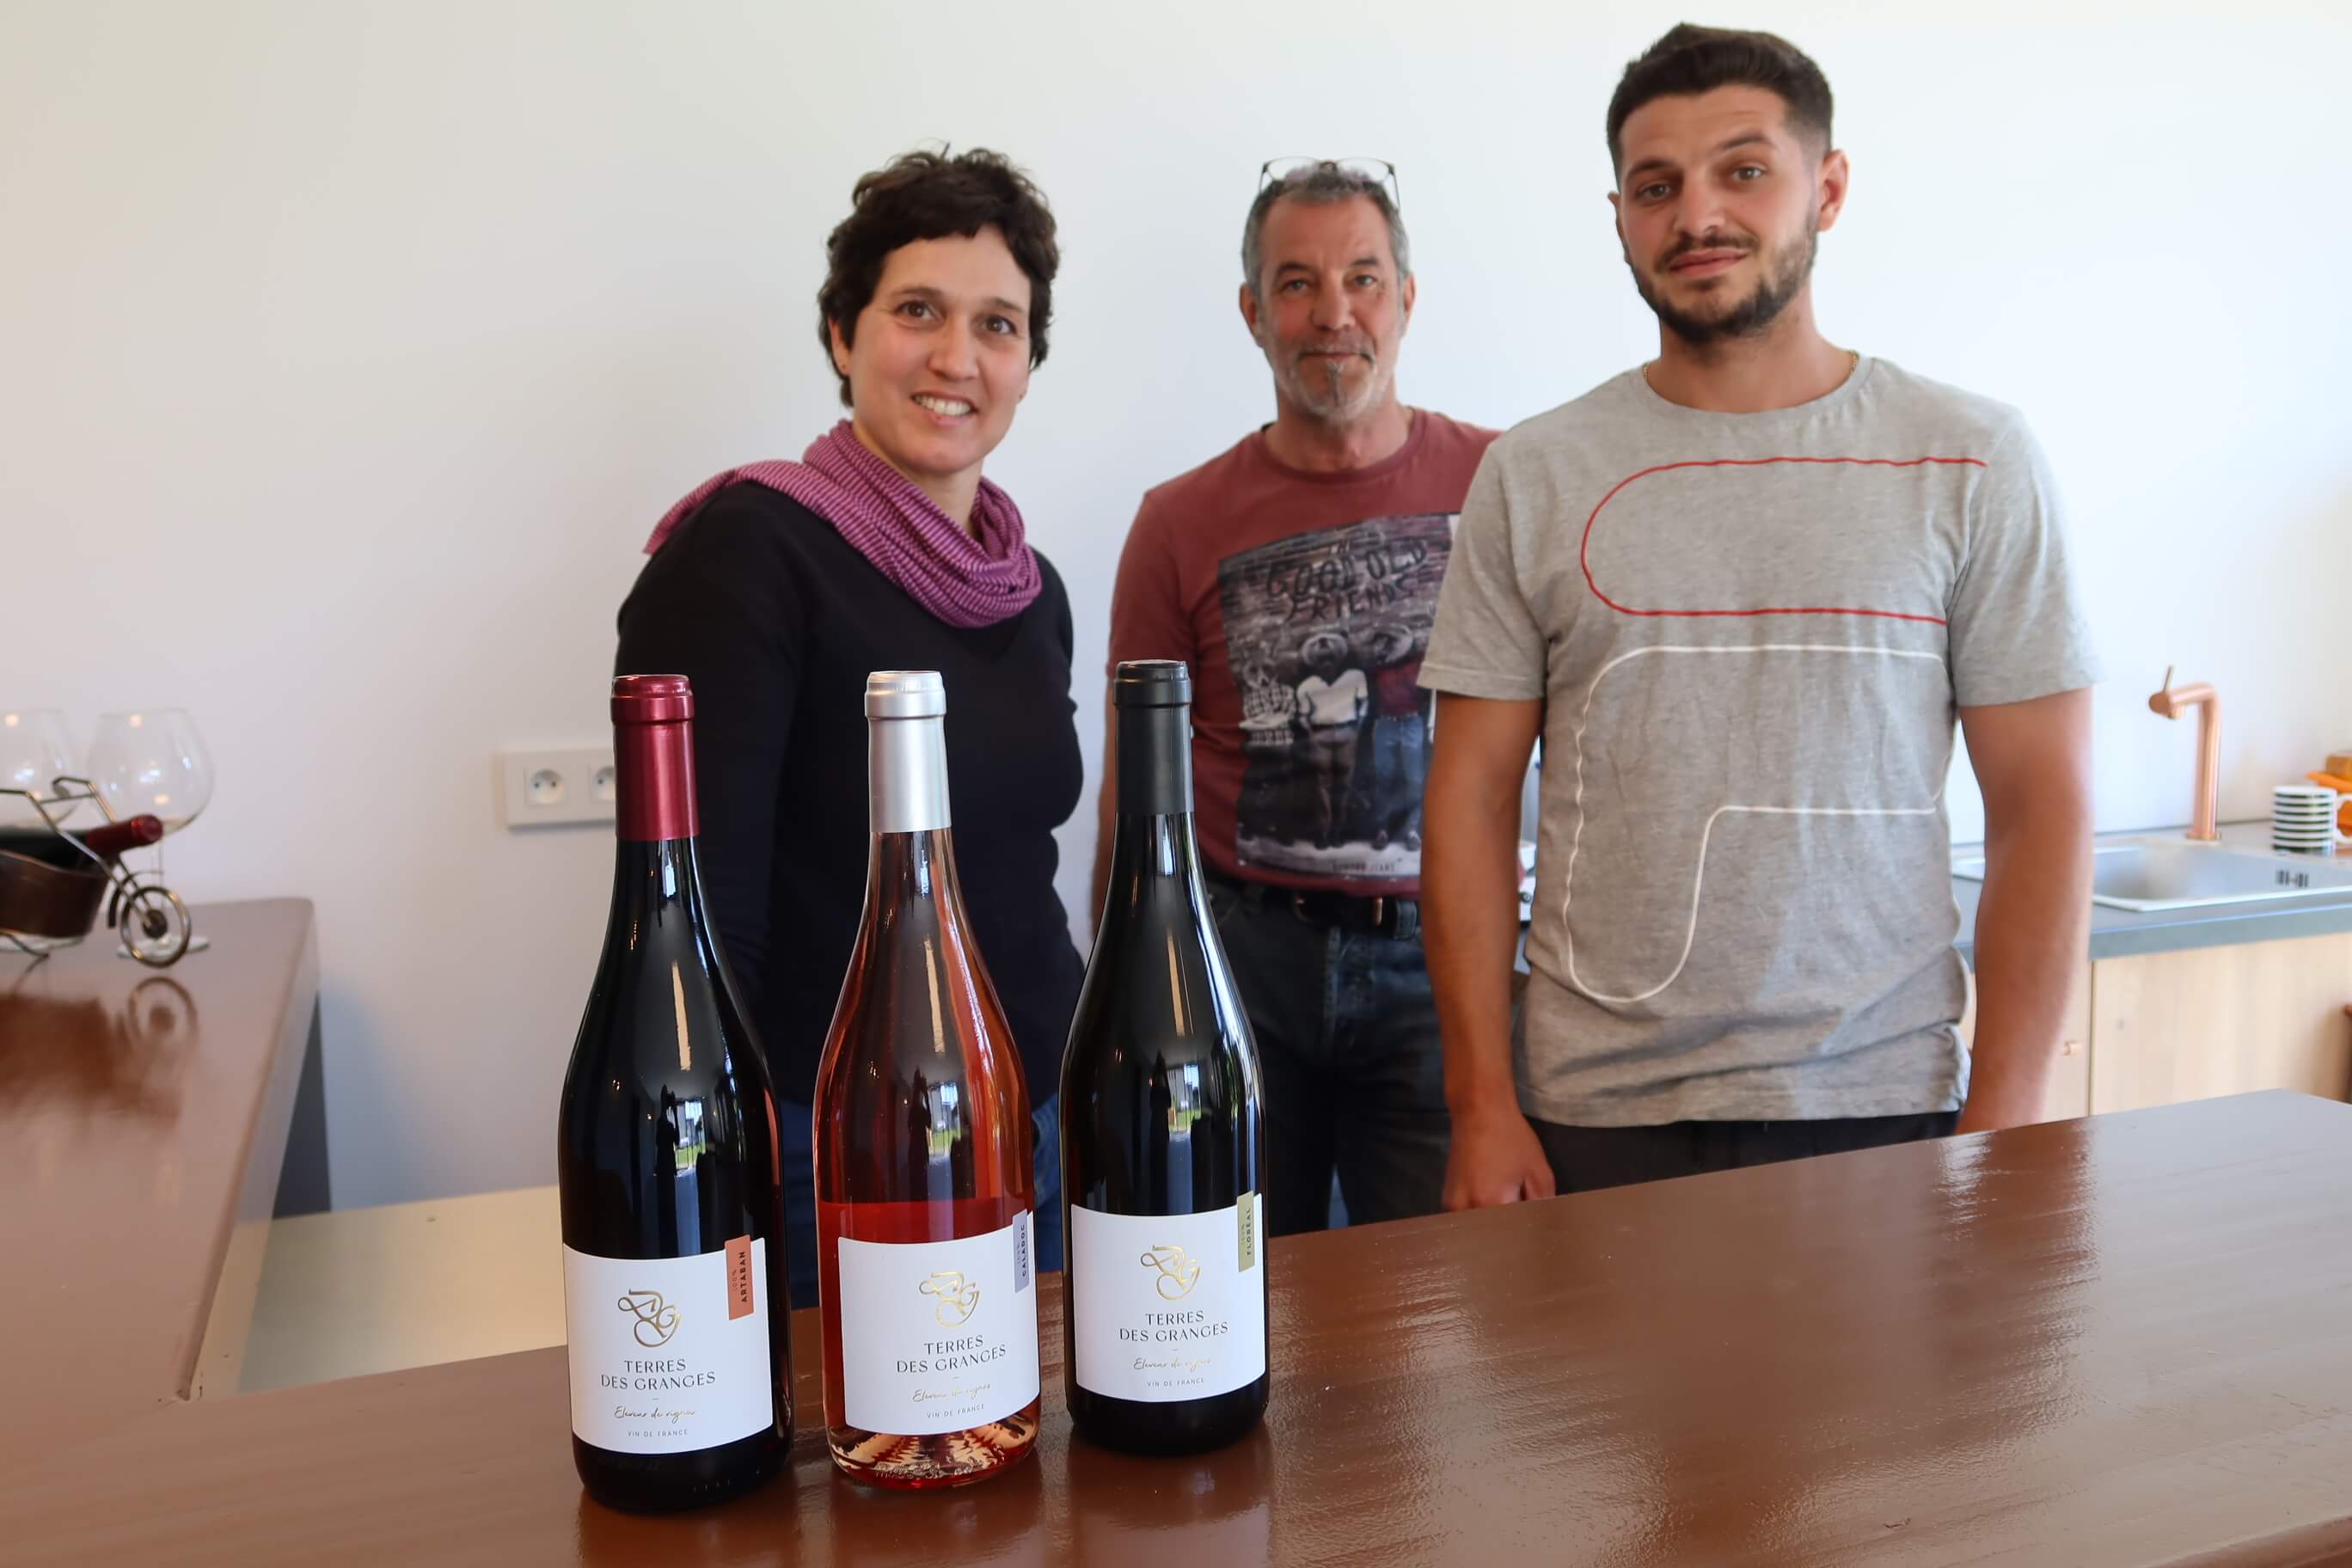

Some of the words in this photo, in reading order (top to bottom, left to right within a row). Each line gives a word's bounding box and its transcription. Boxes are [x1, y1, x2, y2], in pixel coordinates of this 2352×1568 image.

[1365, 537, 1428, 579] OLD
[1284, 572, 1414, 622] FRIENDS
[738, 1251, 748, 1303] ARTABAN
[1145, 1310, 1205, 1326] TERRES
[1119, 1327, 1149, 1342] DES
[1155, 1321, 1229, 1342] GRANGES
[924, 1334, 984, 1356] TERRES
[624, 1358, 687, 1374] TERRES
[897, 1360, 928, 1375] DES
[935, 1344, 1007, 1372] GRANGES
[601, 1374, 628, 1389] DES
[634, 1371, 716, 1391] GRANGES
[1177, 1377, 1204, 1387] FRANCE
[958, 1404, 984, 1415] FRANCE
